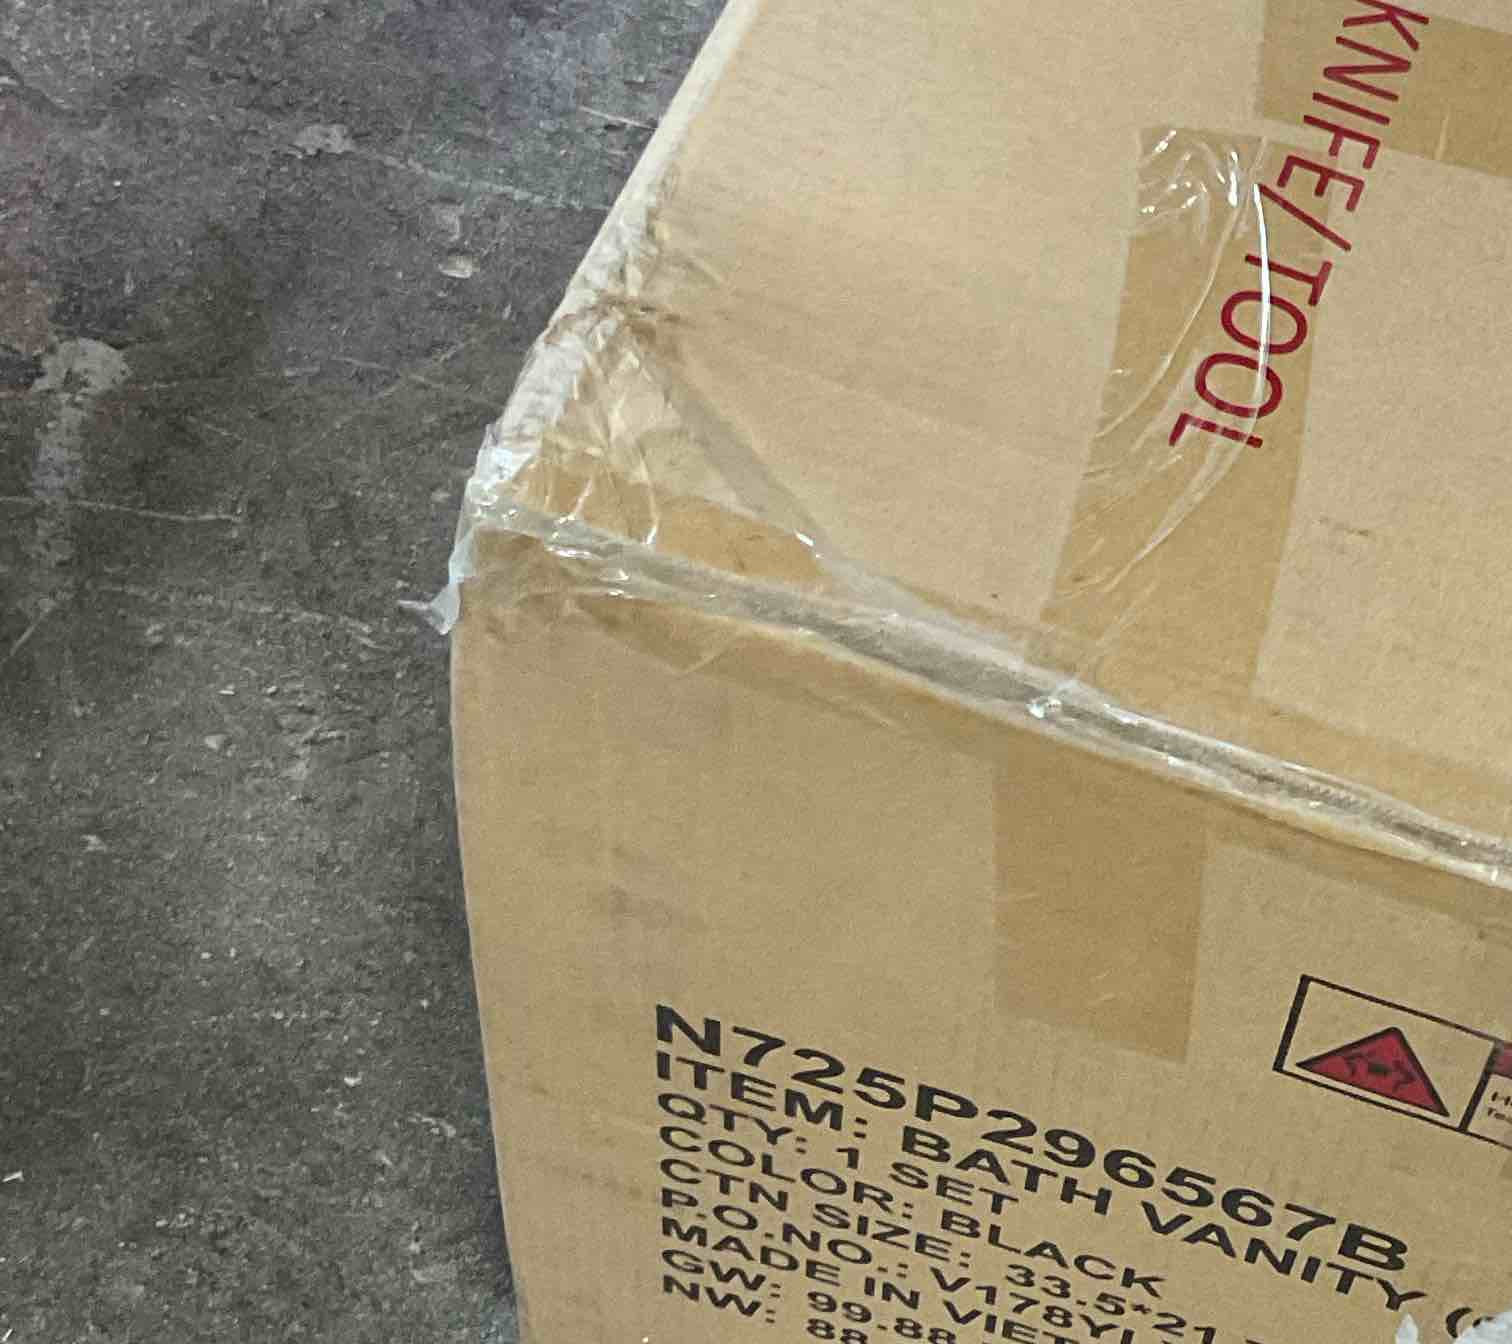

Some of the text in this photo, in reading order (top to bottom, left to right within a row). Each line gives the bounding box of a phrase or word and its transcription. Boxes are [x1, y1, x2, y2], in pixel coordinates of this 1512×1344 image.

[655, 1003, 1412, 1273] N725P296567B
[655, 1051, 868, 1140] ITEM:
[901, 1126, 1112, 1216] BATH
[1141, 1200, 1429, 1312] VANITY
[657, 1092, 1019, 1215] QTY: 1 SET
[659, 1126, 1167, 1300] COLOR: BLACK
[660, 1158, 789, 1212] CTN
[813, 1202, 970, 1269] SIZE:
[661, 1188, 908, 1278] P.O.NO.:
[661, 1216, 841, 1287] MADE
[864, 1278, 920, 1310] IN
[661, 1249, 781, 1298] GW:
[662, 1275, 776, 1324] NW:
